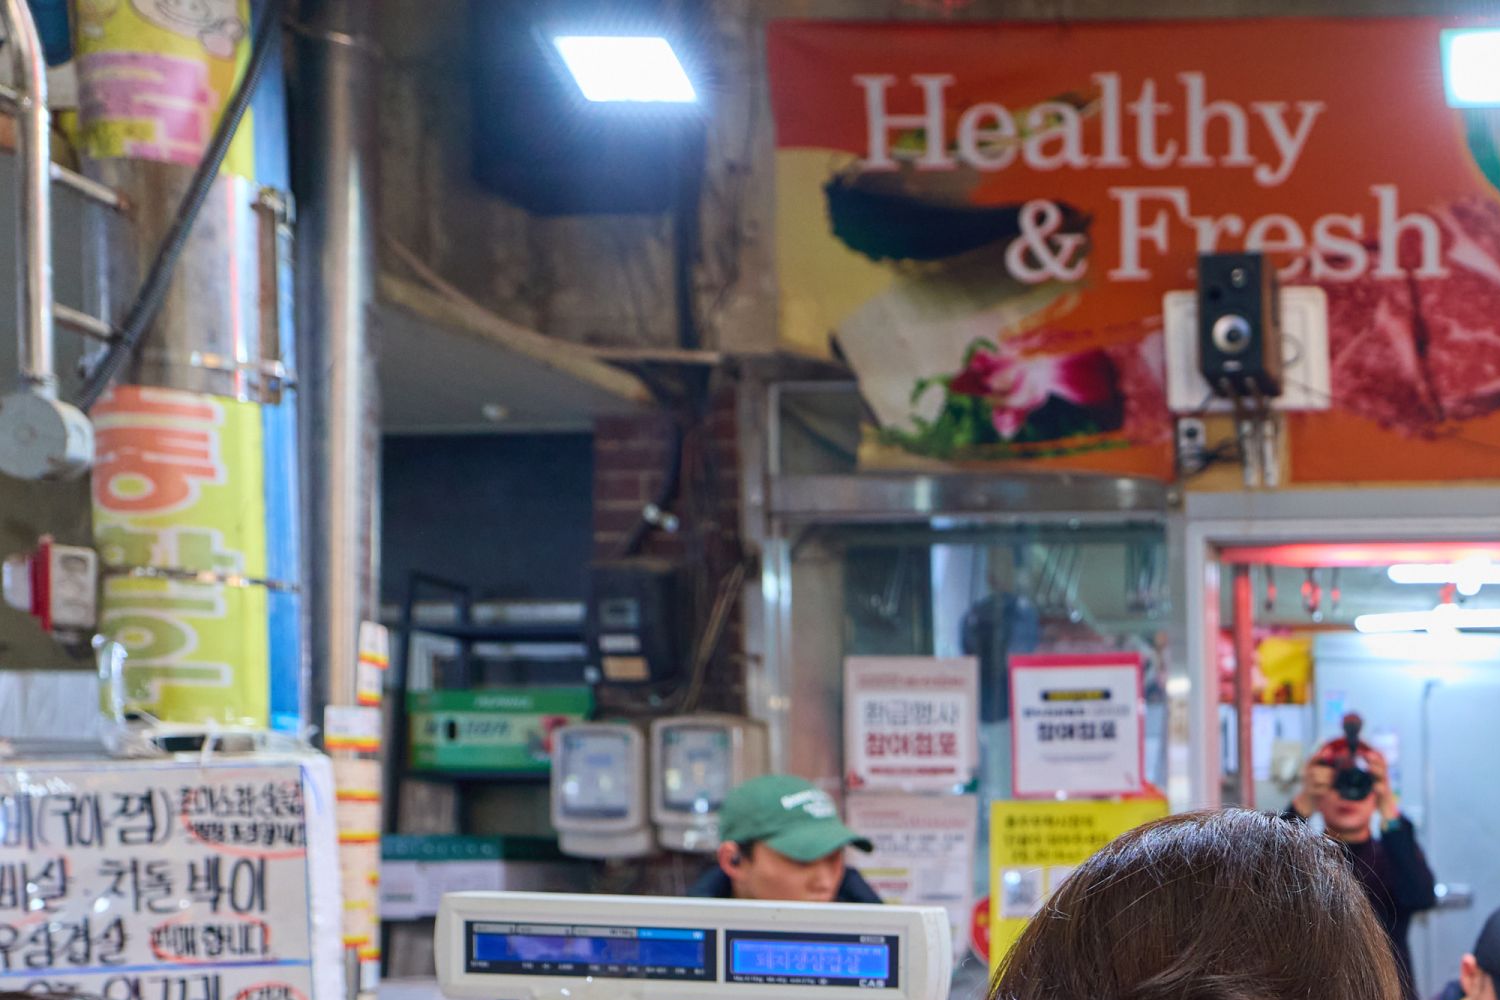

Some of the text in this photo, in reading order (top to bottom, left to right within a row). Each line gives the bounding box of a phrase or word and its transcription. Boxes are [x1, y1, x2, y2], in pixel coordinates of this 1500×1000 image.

[853, 72, 1325, 186] Healthy
[1004, 184, 1451, 284] & Fresh
